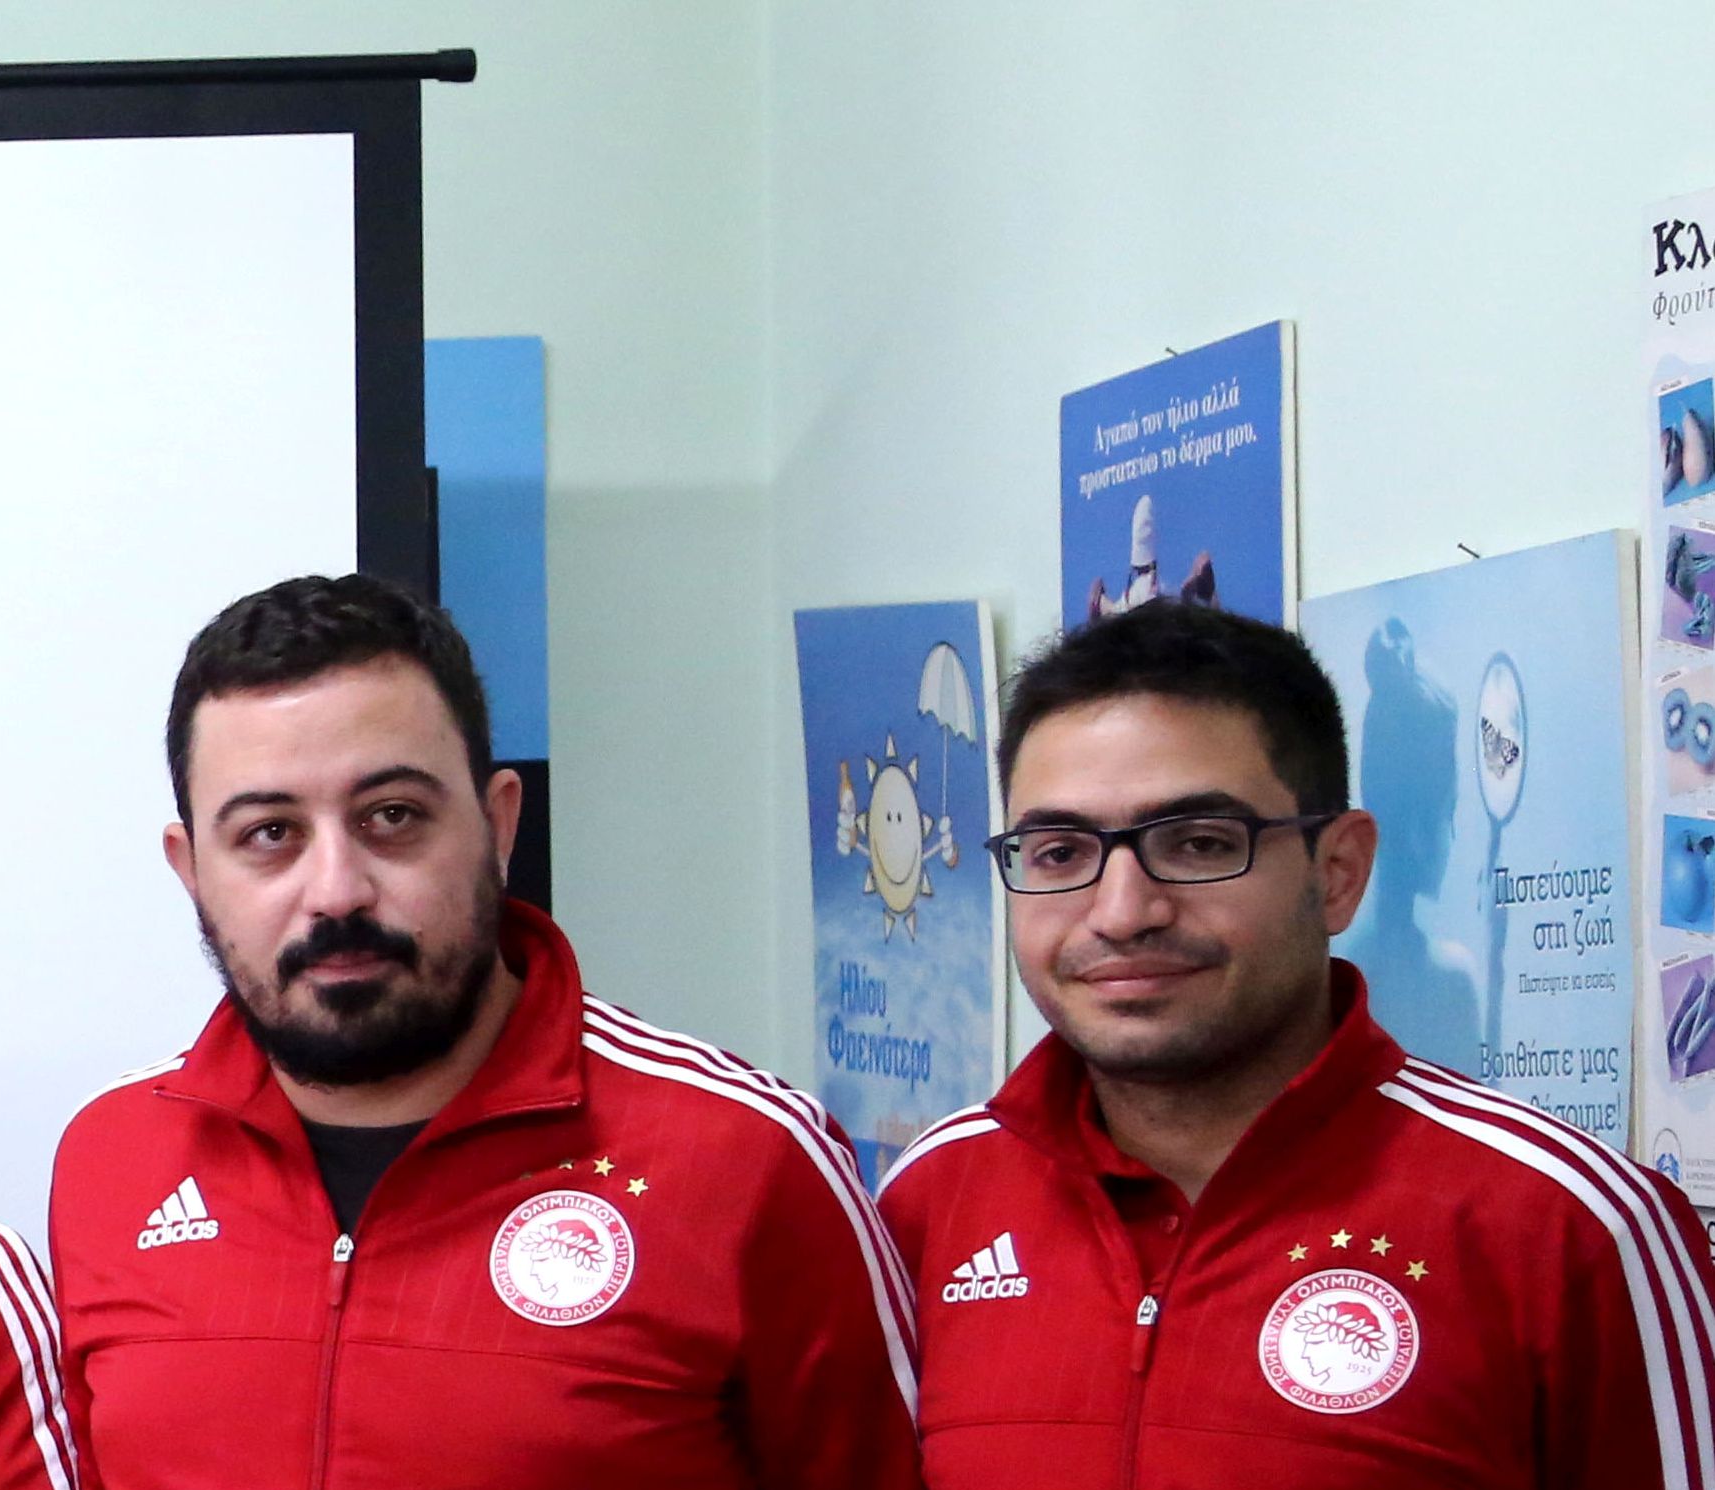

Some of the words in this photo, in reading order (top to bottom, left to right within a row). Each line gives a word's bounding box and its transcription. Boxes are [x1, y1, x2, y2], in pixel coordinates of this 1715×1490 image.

[1652, 219, 1715, 277] Κλ
[1094, 410, 1138, 455] Αγαπώ
[1141, 411, 1164, 436] τον
[1168, 397, 1198, 433] ήλιο
[1202, 377, 1241, 416] αλλά
[1079, 447, 1158, 500] προστατεύω
[1162, 449, 1176, 470] το
[1179, 431, 1223, 467] δέρμα
[1494, 860, 1613, 906] Πιστεύουμε
[1533, 922, 1568, 951] στη
[1573, 905, 1614, 955] ζωή
[1479, 1040, 1574, 1081] Βοηθήστε
[1581, 1049, 1620, 1084] μας
[137, 1219, 220, 1250] adidas
[519, 1196, 618, 1228] ΟΛΥΜΠΙΑΚΟΣ
[522, 1297, 605, 1320] ΦΙΛΑΘΛΩΝ
[604, 1231, 629, 1296] ΠΕΙΡΑΙΩΣ
[942, 1274, 1029, 1303] adidas
[1297, 1275, 1402, 1315] ΟΛΥΜΠΙΑΚΟΣ
[1289, 1385, 1381, 1408] ΦΙΛΑΘΛΩΝ
[1384, 1318, 1413, 1389] ΠΕΙΡΑΙΩΣ
